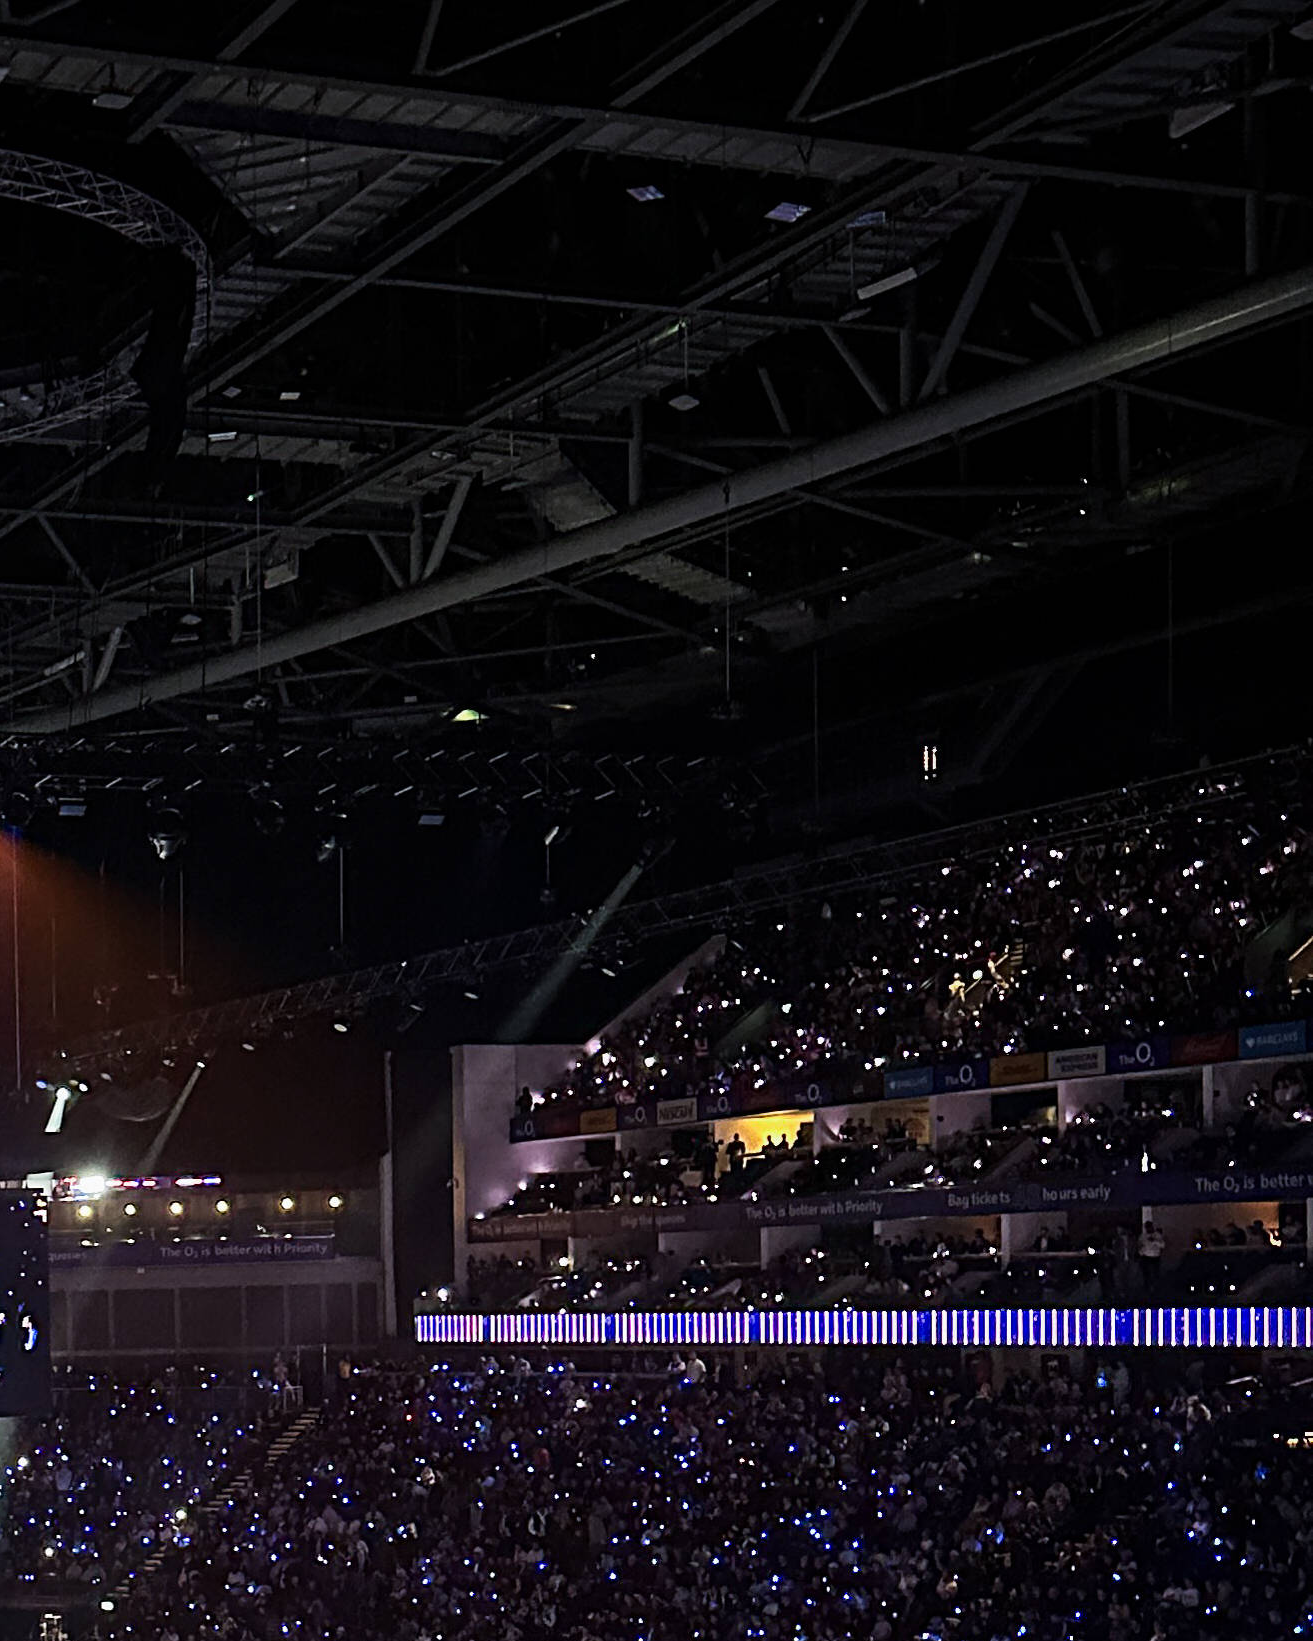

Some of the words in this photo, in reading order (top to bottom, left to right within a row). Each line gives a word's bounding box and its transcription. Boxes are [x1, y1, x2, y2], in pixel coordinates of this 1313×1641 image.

[1119, 1054, 1135, 1065] The
[1194, 1177, 1221, 1192] The
[1244, 1175, 1255, 1190] is
[1260, 1173, 1306, 1190] better
[948, 1193, 969, 1208] Bag
[971, 1191, 1011, 1205] tickets
[1042, 1187, 1079, 1201] hours
[1080, 1184, 1111, 1202] early
[745, 1207, 763, 1219] The
[789, 1203, 818, 1217] better
[820, 1202, 844, 1216] with
[845, 1201, 883, 1215] Priority
[160, 1246, 181, 1258] The
[201, 1246, 212, 1257] is
[215, 1244, 250, 1257] better
[252, 1244, 281, 1256] with
[284, 1243, 328, 1258] Priority
